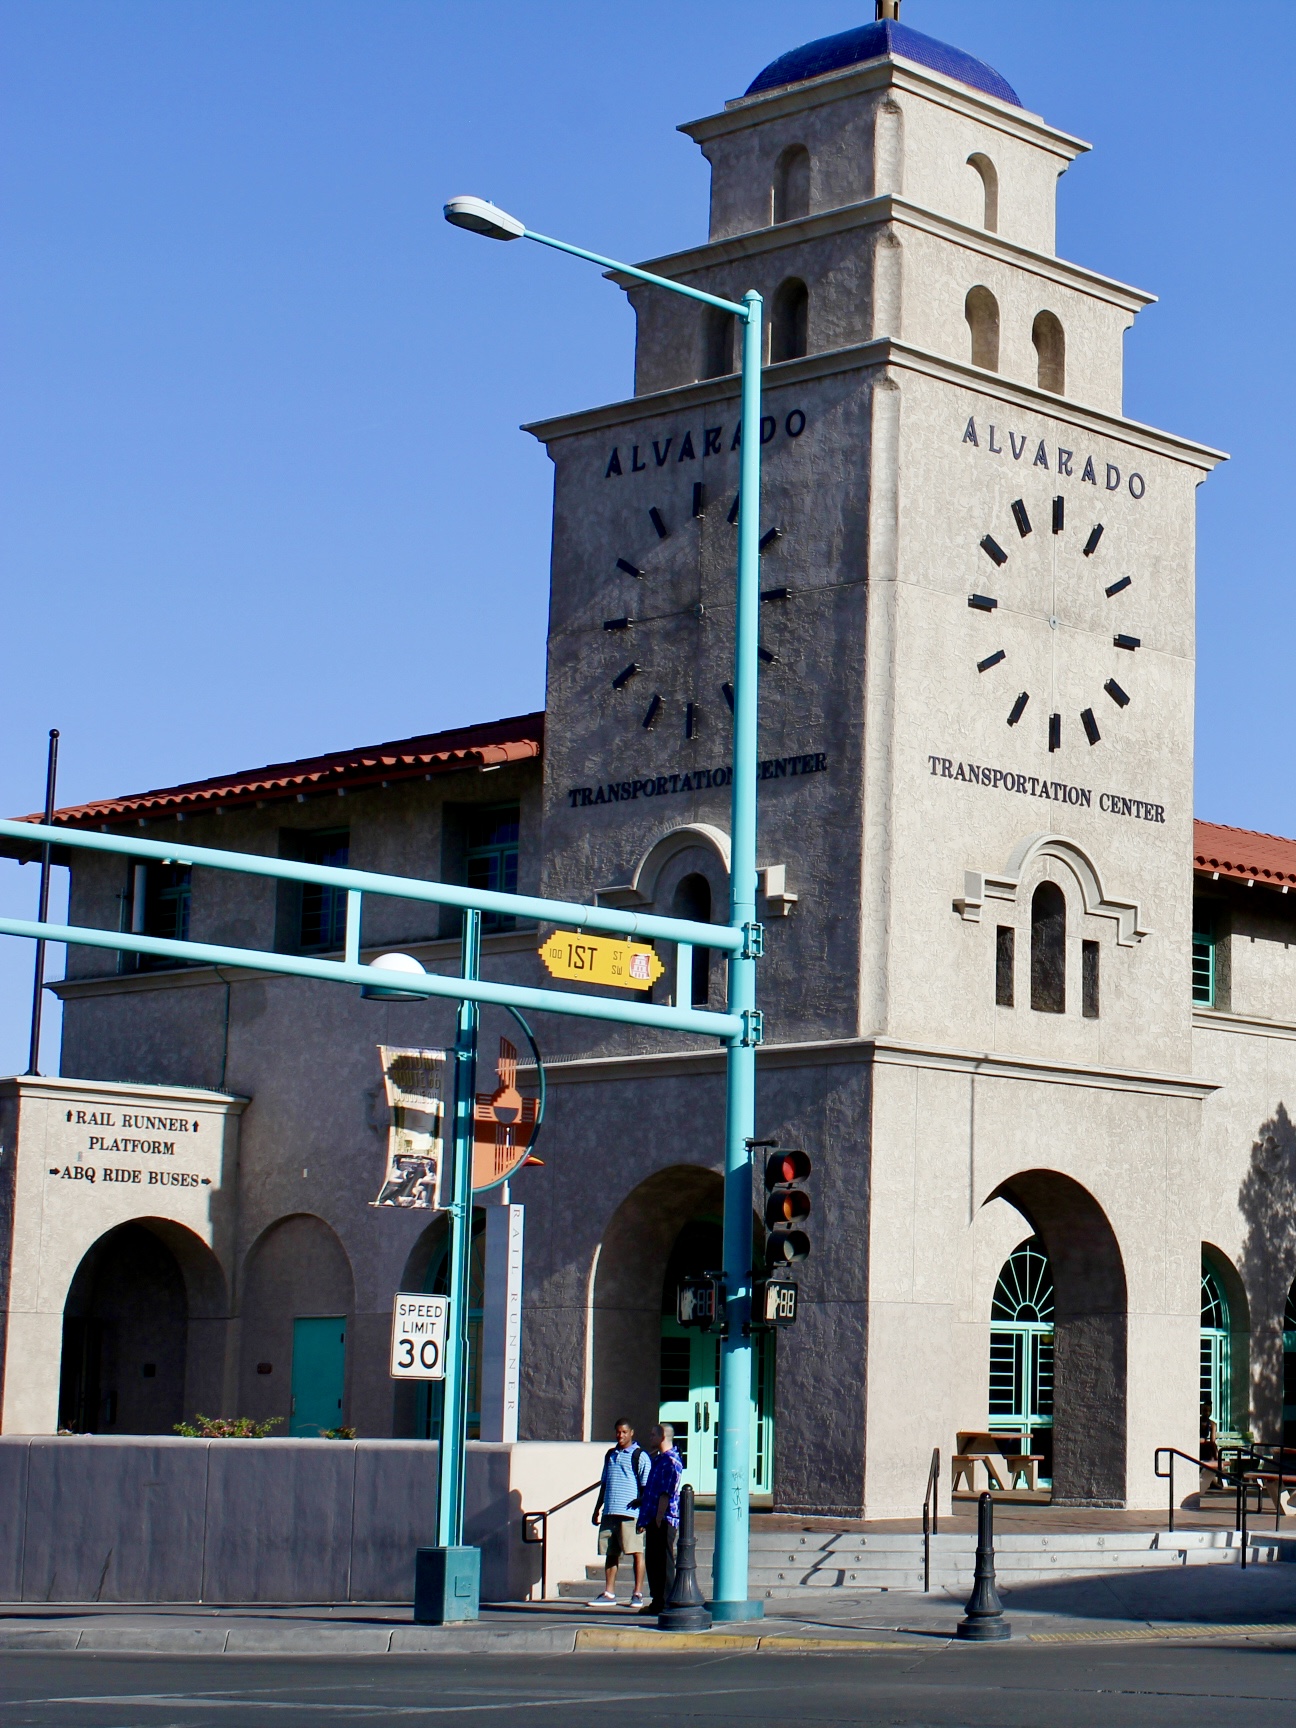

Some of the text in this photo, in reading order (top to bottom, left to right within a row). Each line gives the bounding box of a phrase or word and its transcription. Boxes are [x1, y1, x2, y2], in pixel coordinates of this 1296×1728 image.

[962, 416, 1146, 499] ALVARADO
[928, 755, 1166, 824] TRANSPORTATION CENTER
[549, 944, 623, 971] 100 1ST ST
[611, 965, 623, 975] SW
[393, 1069, 441, 1090] ROUTE 66
[76, 1110, 189, 1132] RAIL RUNNER
[88, 1136, 176, 1155] PLATFORM
[61, 1166, 200, 1187] ABQ RIDE BUSES
[399, 1304, 443, 1318] SPEED
[507, 1209, 520, 1410] RAIL RUNNER
[402, 1321, 436, 1335] LIMIT
[398, 1338, 439, 1370] 30
